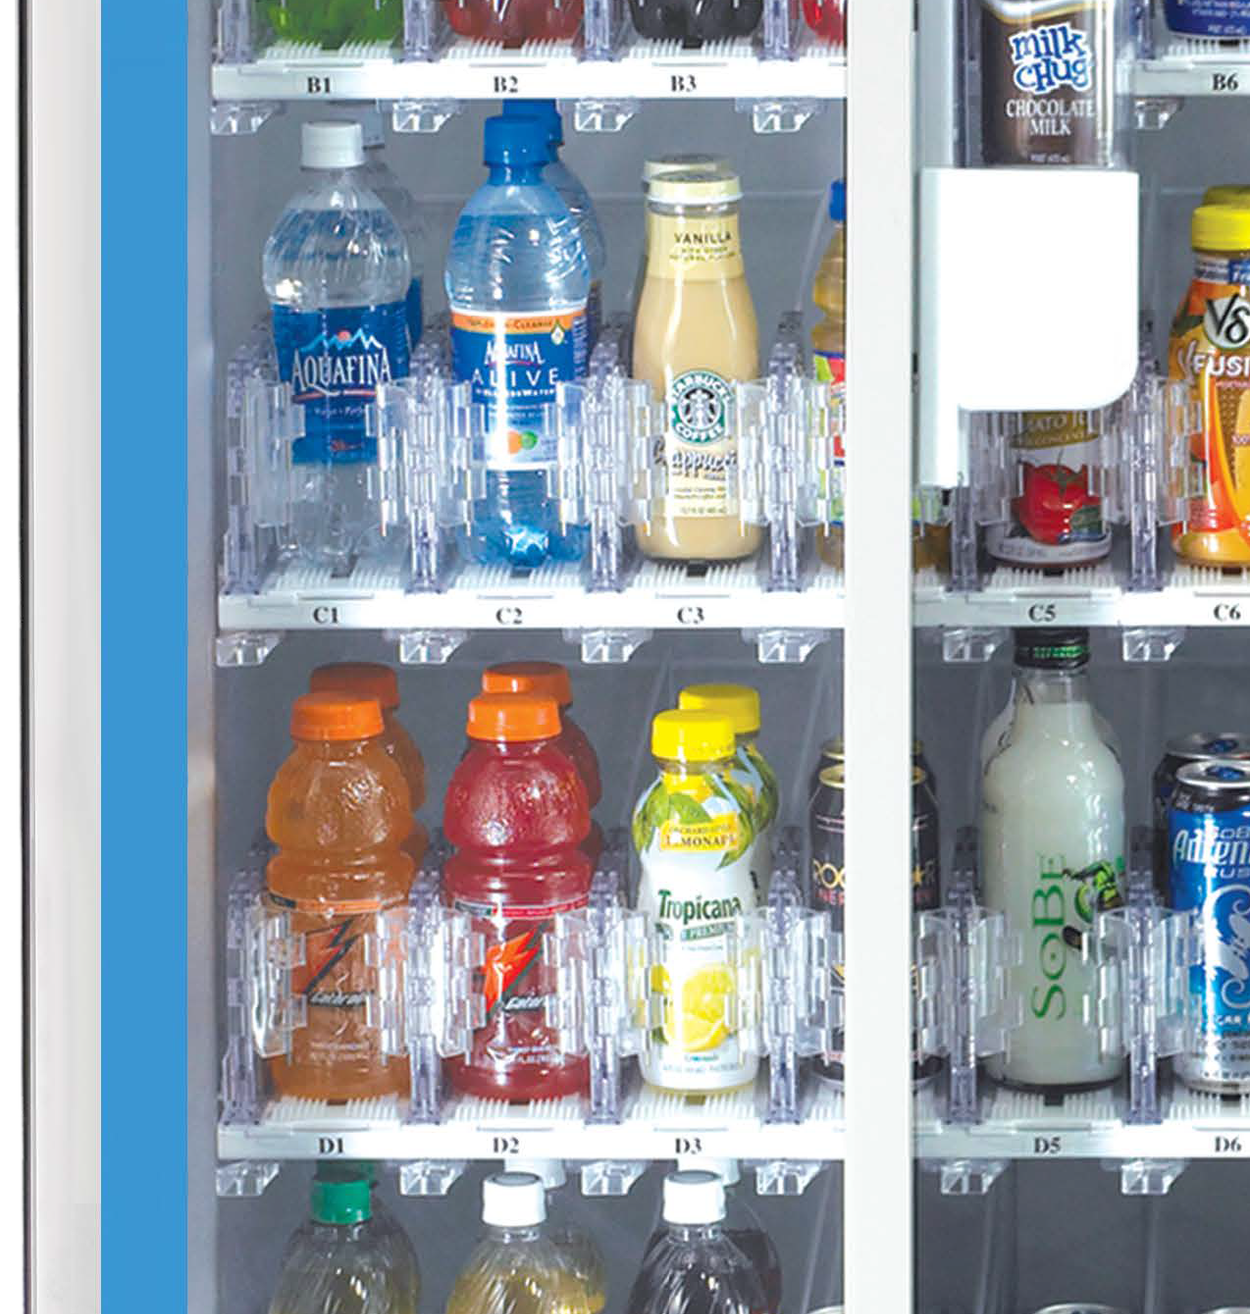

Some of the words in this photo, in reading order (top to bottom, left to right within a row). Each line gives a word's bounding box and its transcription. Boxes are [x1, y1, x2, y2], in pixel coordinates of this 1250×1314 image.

[1012, 28, 1087, 62] milk
[306, 76, 331, 94] B1
[493, 75, 518, 93] B2
[671, 75, 697, 92] B3
[1212, 73, 1239, 91] B6
[1006, 98, 1095, 118] CHOCOLATE
[1030, 119, 1072, 136] MILK
[673, 231, 732, 244] VANILLA
[291, 348, 392, 395] AQUAFINA
[472, 368, 558, 387] ALIVE
[312, 606, 338, 624] C1
[495, 606, 523, 624] C2
[677, 606, 704, 624] C3
[1028, 604, 1056, 622] C5
[1213, 604, 1241, 621] C6
[657, 889, 742, 925] Tropicana
[318, 1137, 344, 1155] D1
[493, 1137, 520, 1154] D2
[675, 1137, 702, 1155] D3
[1034, 1136, 1061, 1154] D5
[1215, 1136, 1242, 1153] D6
